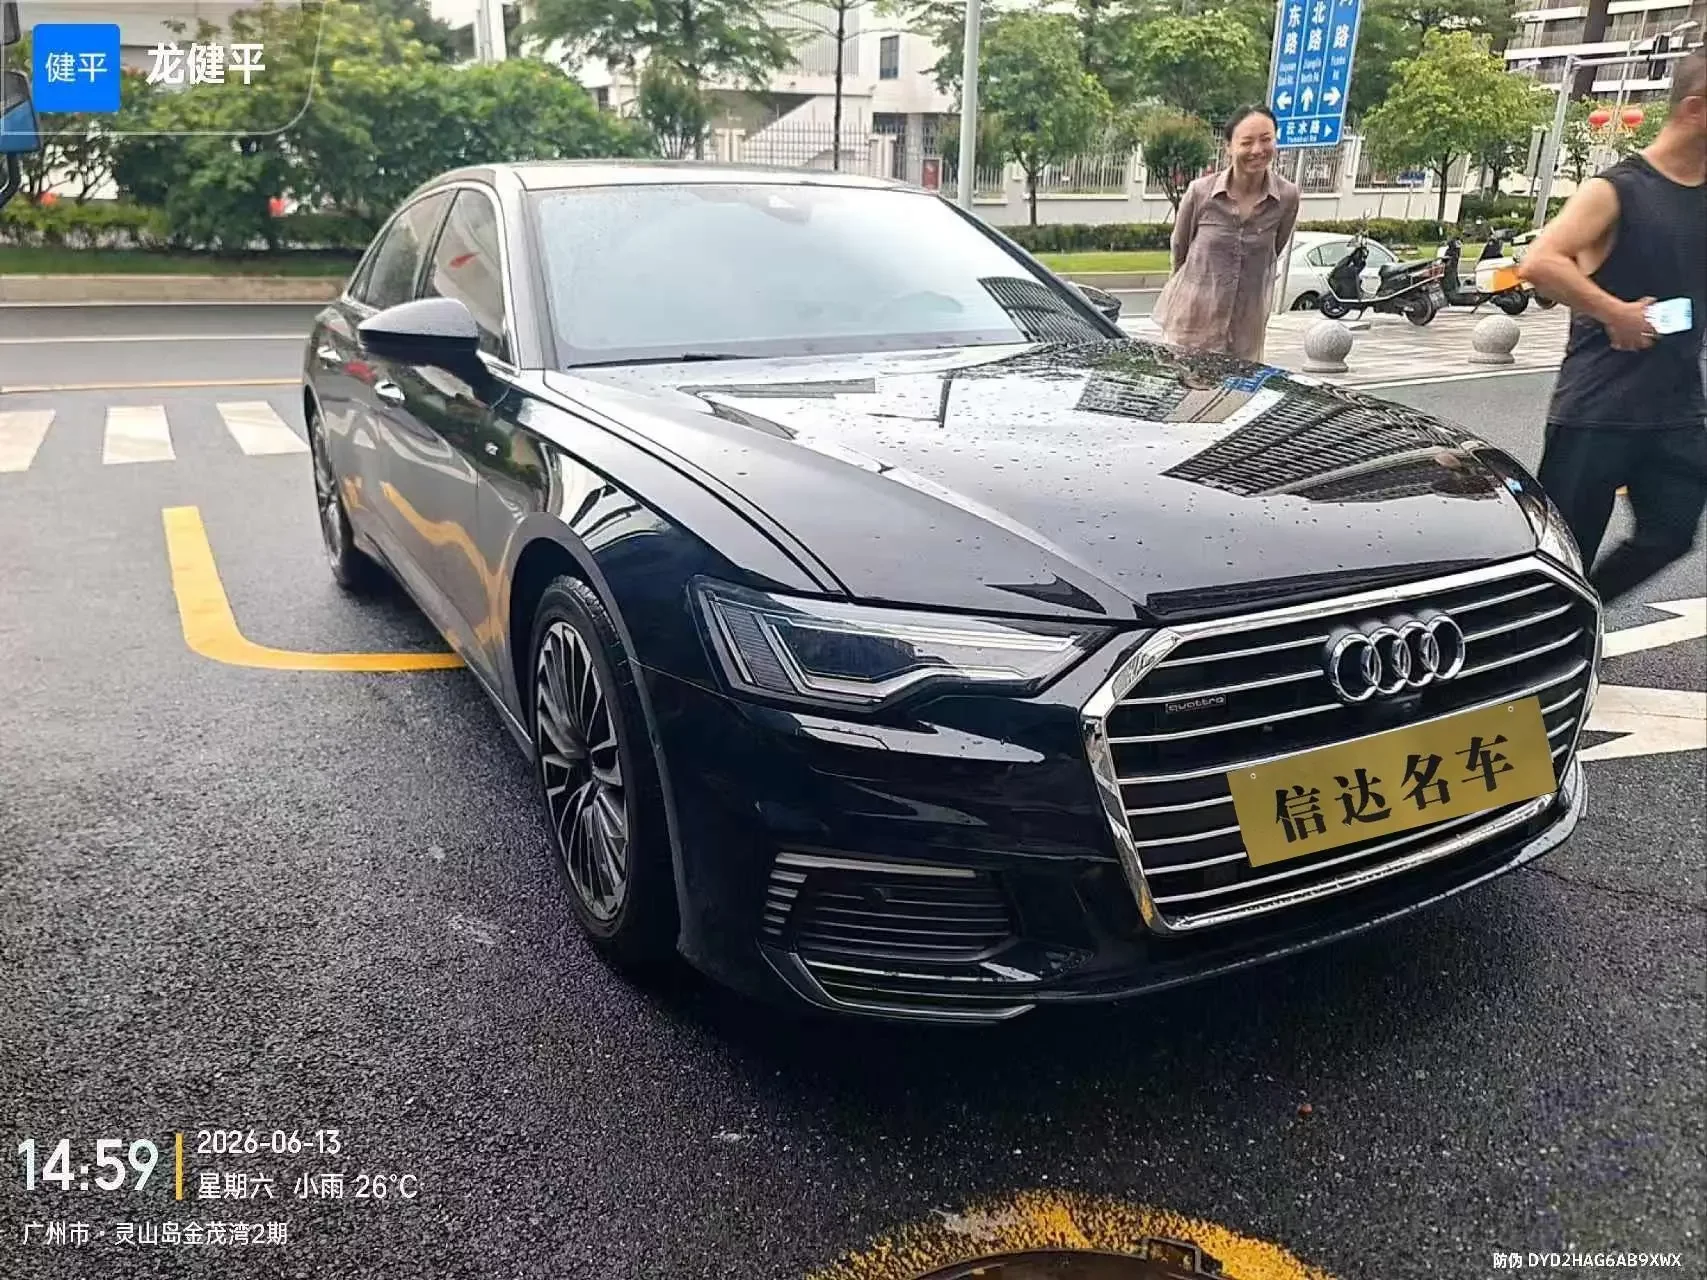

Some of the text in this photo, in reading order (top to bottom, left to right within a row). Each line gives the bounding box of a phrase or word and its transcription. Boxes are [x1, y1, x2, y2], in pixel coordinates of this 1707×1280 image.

[1284, 4, 1302, 55] 东路
[1307, 0, 1327, 51] 北路
[1333, 0, 1353, 48] 路
[1286, 119, 1320, 135] 云水路
[1168, 696, 1225, 713] quattro
[1274, 734, 1514, 844] 信达名车
